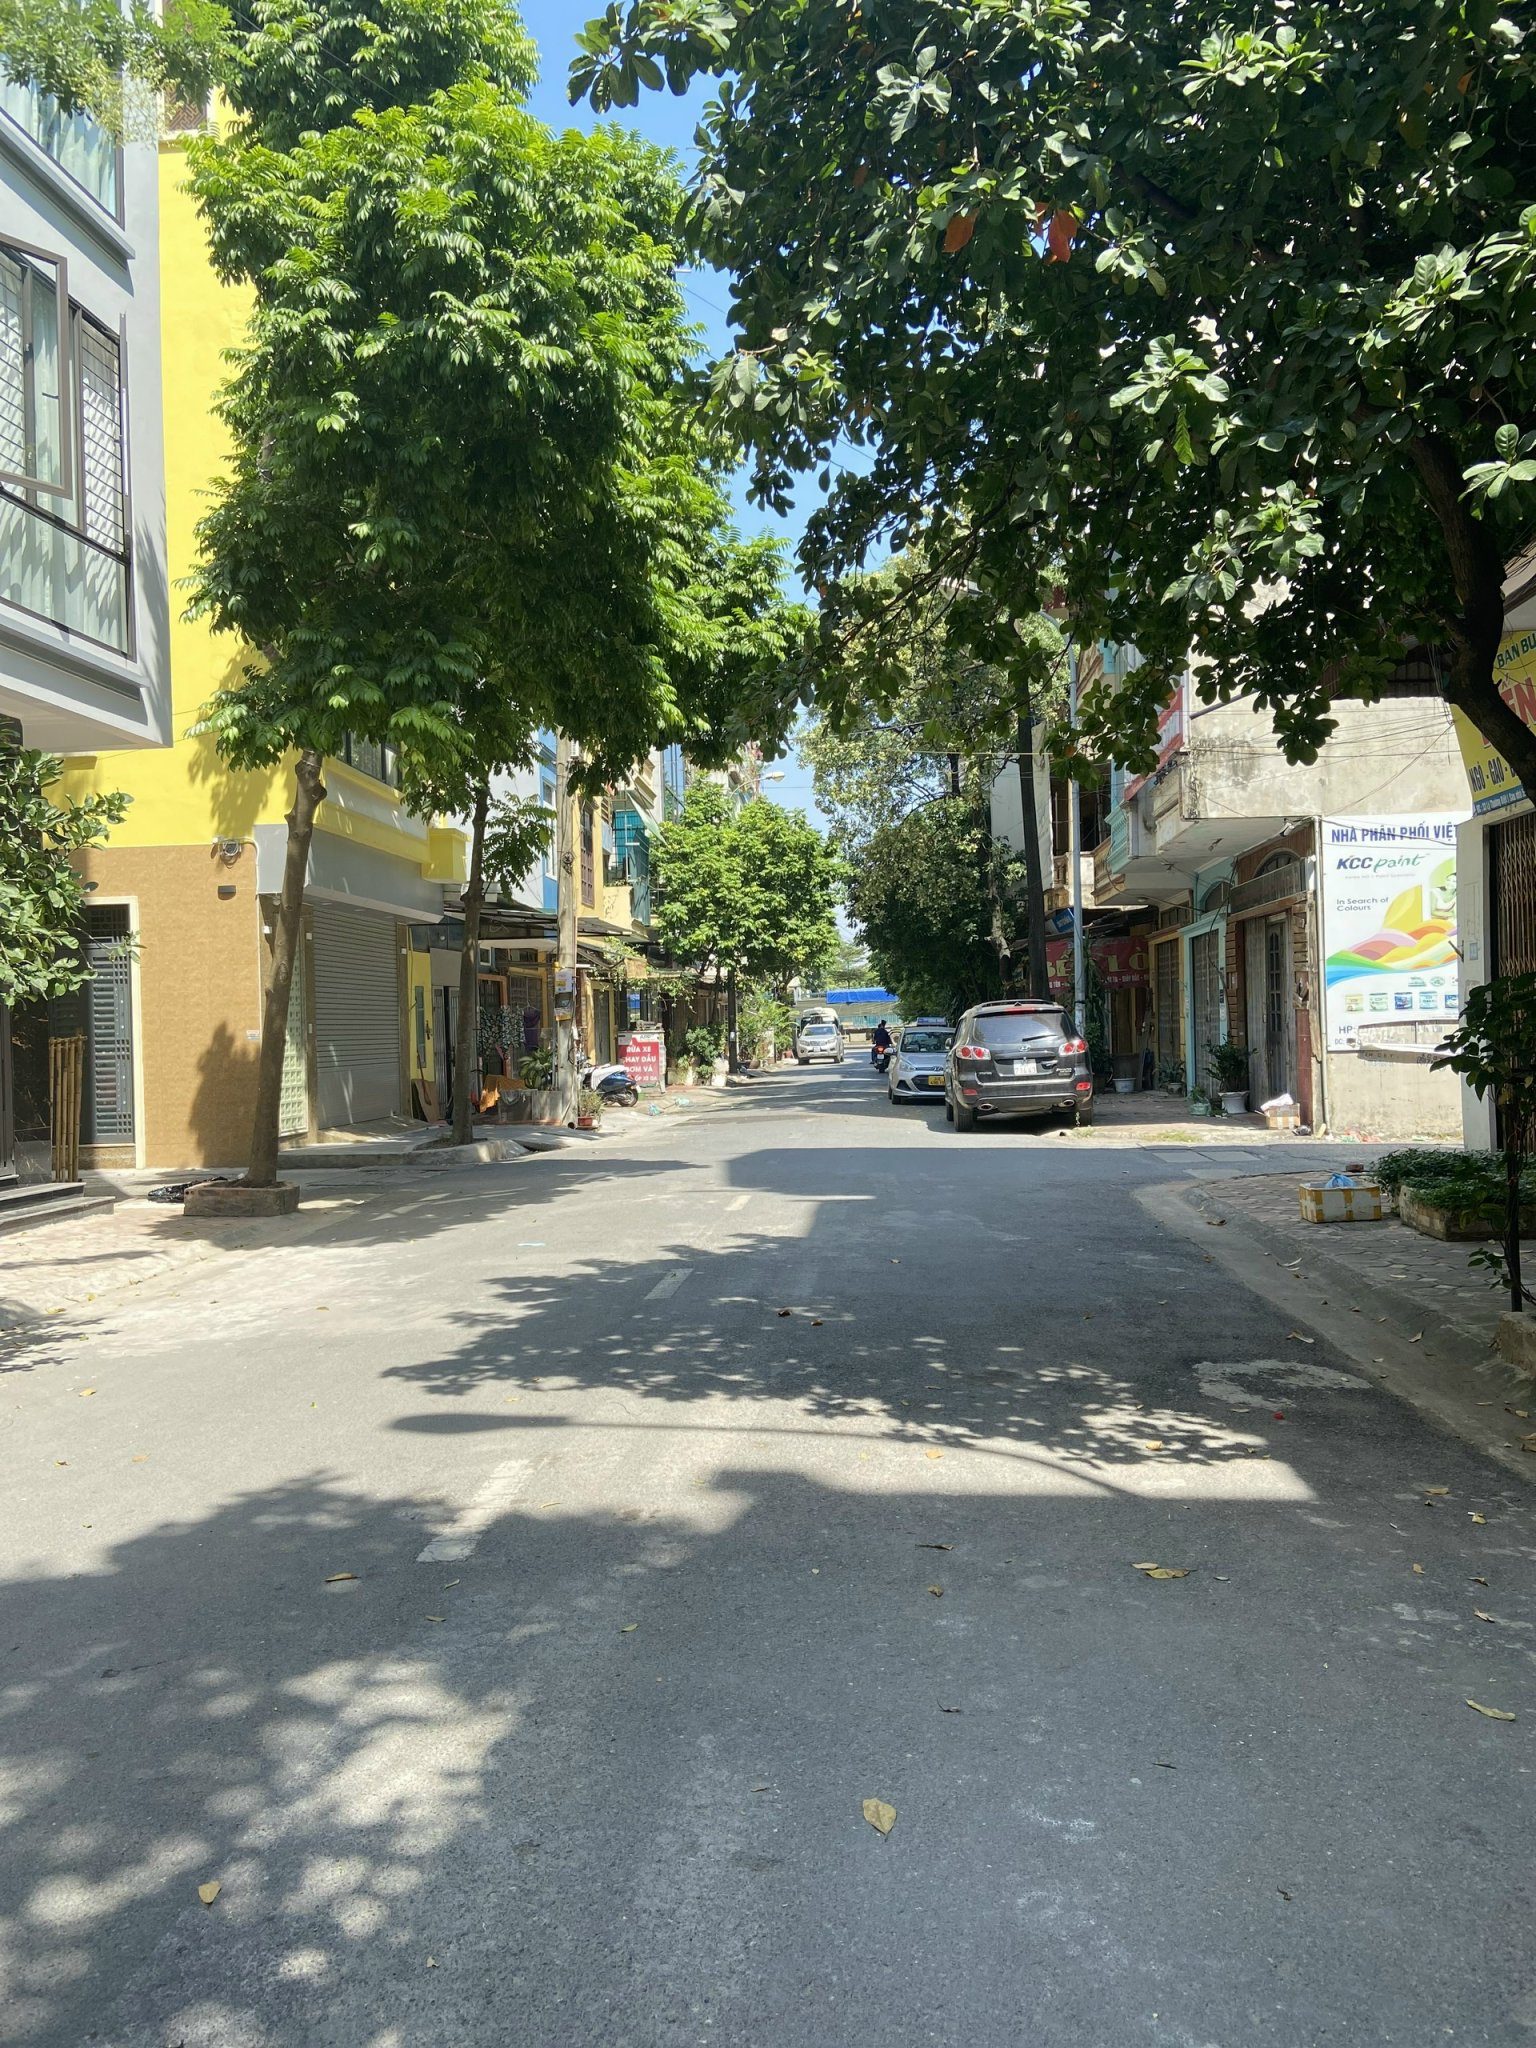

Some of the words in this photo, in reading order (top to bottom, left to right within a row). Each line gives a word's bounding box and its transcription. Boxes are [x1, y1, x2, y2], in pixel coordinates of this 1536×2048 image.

[1331, 826, 1357, 843] NHÀ
[1361, 825, 1396, 842] PHÂN
[1400, 820, 1430, 840] PHỐI
[1336, 855, 1373, 870] KCC
[1373, 854, 1426, 873] paint
[1347, 897, 1378, 905] Search
[1380, 896, 1389, 904] of
[1336, 904, 1371, 912] Colours
[642, 1045, 652, 1053] XE
